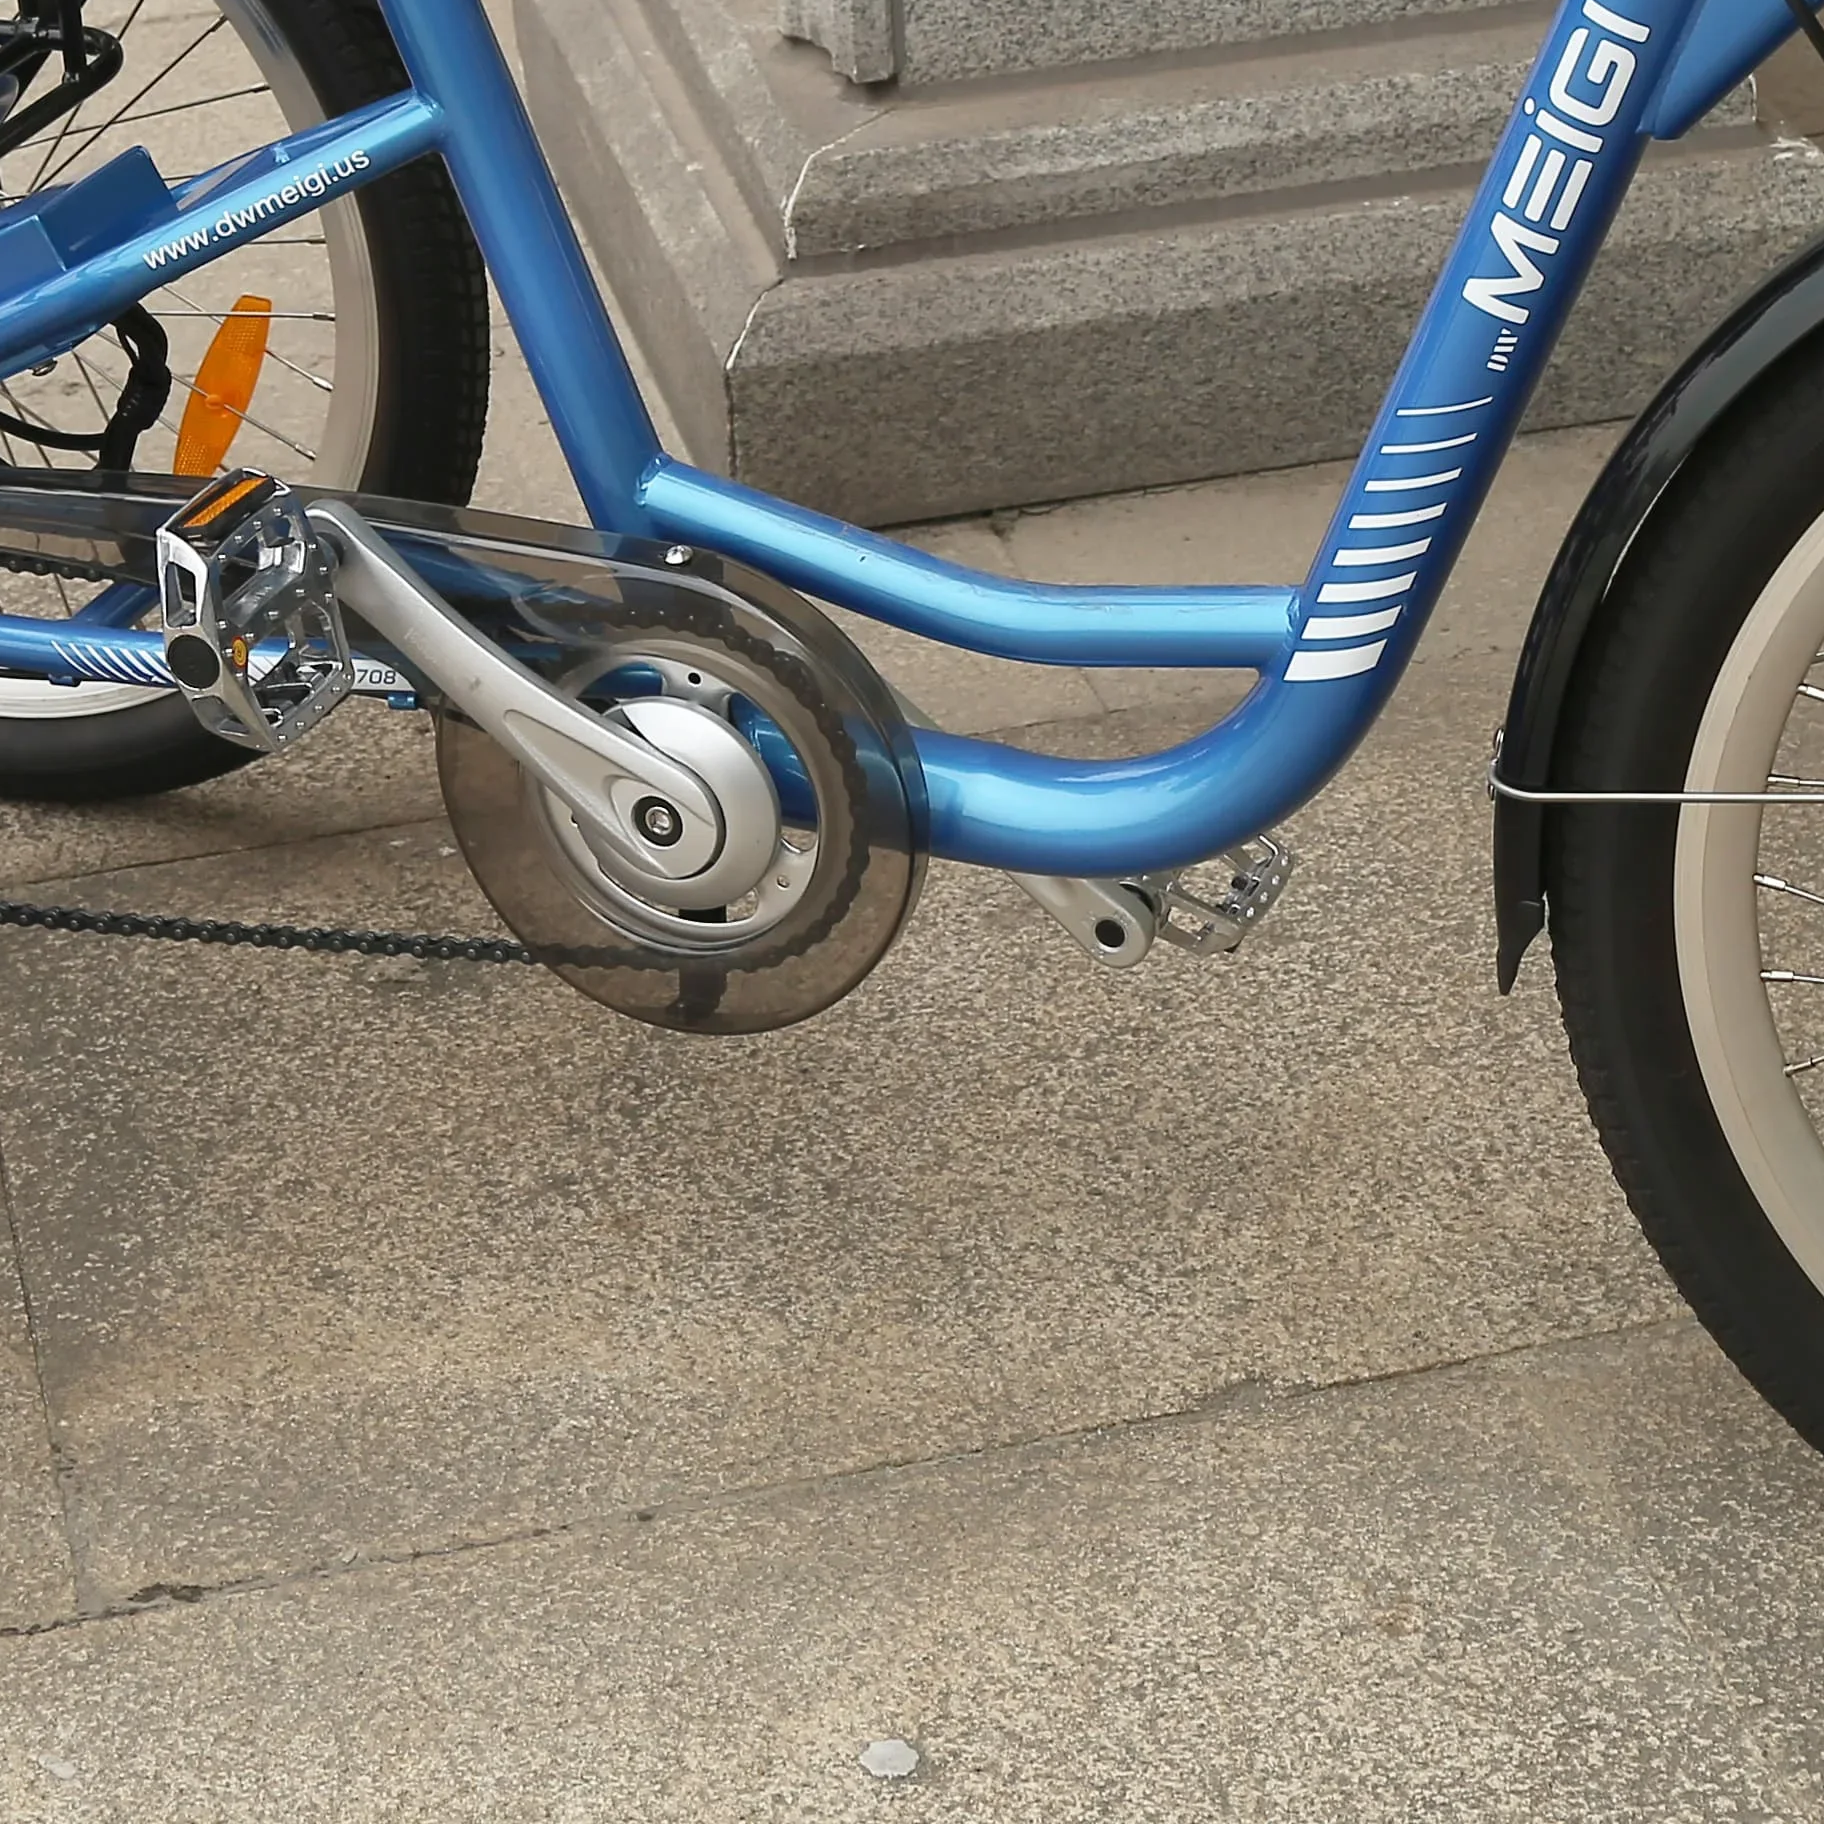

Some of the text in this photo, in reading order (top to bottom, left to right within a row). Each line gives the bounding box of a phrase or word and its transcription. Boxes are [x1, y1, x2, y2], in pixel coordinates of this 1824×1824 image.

[142, 147, 371, 270] www.dwmeigi.us
[1486, 327, 1519, 372] DW
[356, 669, 396, 684] 708
